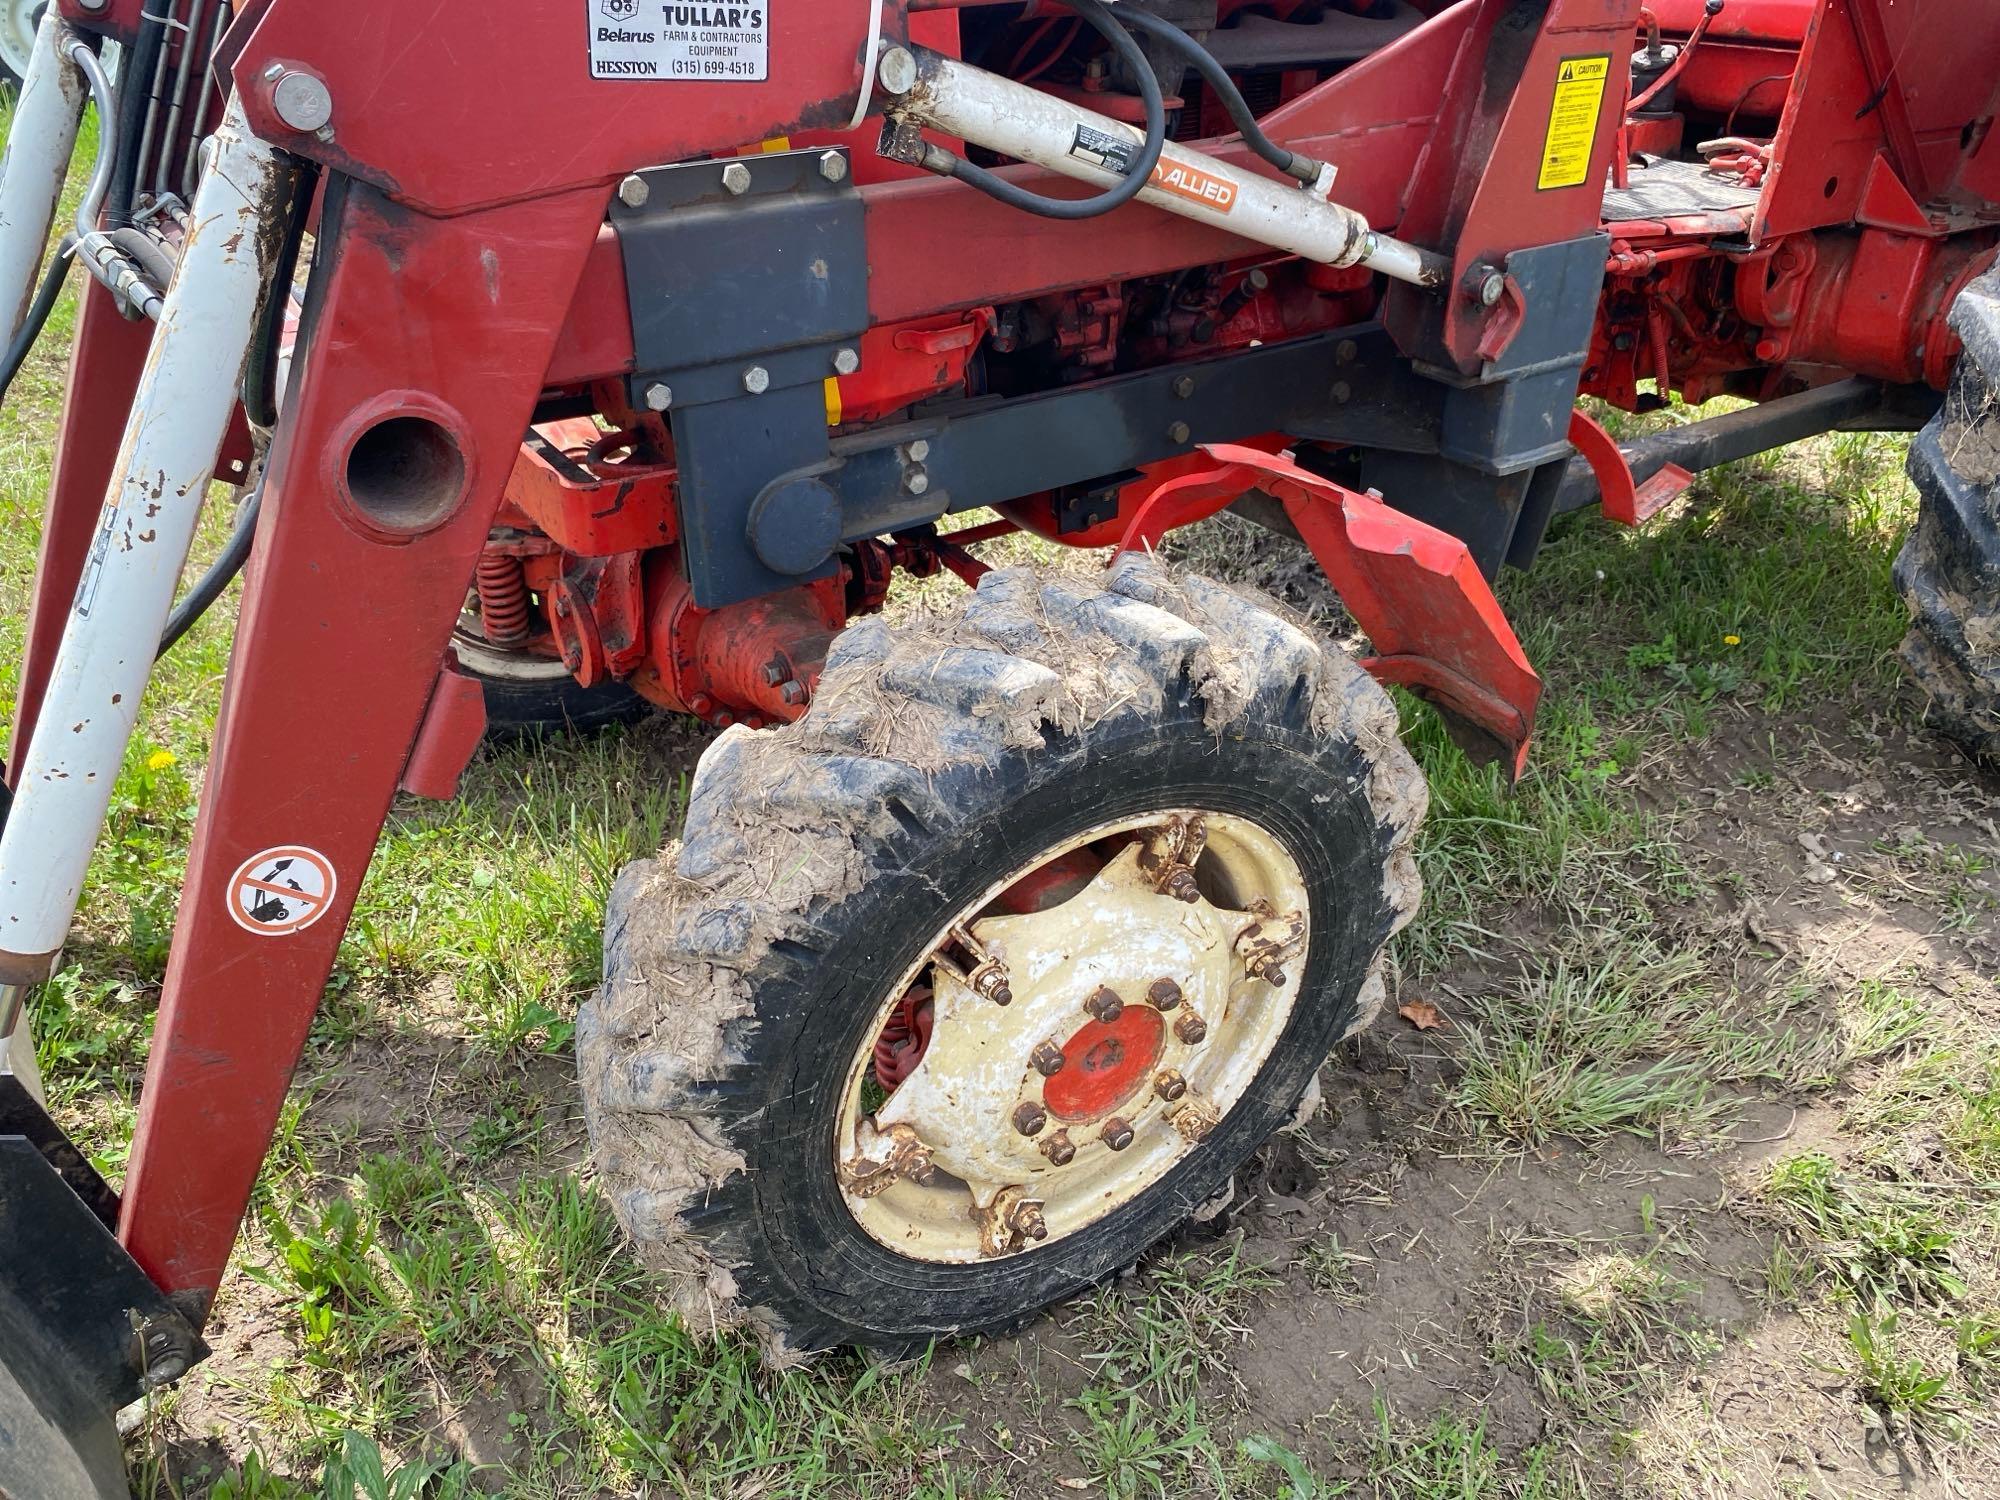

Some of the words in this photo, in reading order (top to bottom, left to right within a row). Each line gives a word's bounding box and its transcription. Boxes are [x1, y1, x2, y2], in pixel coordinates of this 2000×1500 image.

[662, 6, 762, 28] TULLAR'S
[597, 28, 655, 43] Belarus
[663, 30, 689, 41] FARM
[691, 33, 697, 42] &
[700, 32, 762, 44] CONTRACTORS
[689, 46, 738, 57] EQUIPMENT
[596, 61, 657, 74] HESSTON
[672, 59, 700, 75] (315)
[704, 61, 755, 75] 699-4518
[1578, 64, 1603, 75] CAUTION
[1164, 168, 1232, 204] ALLIED
